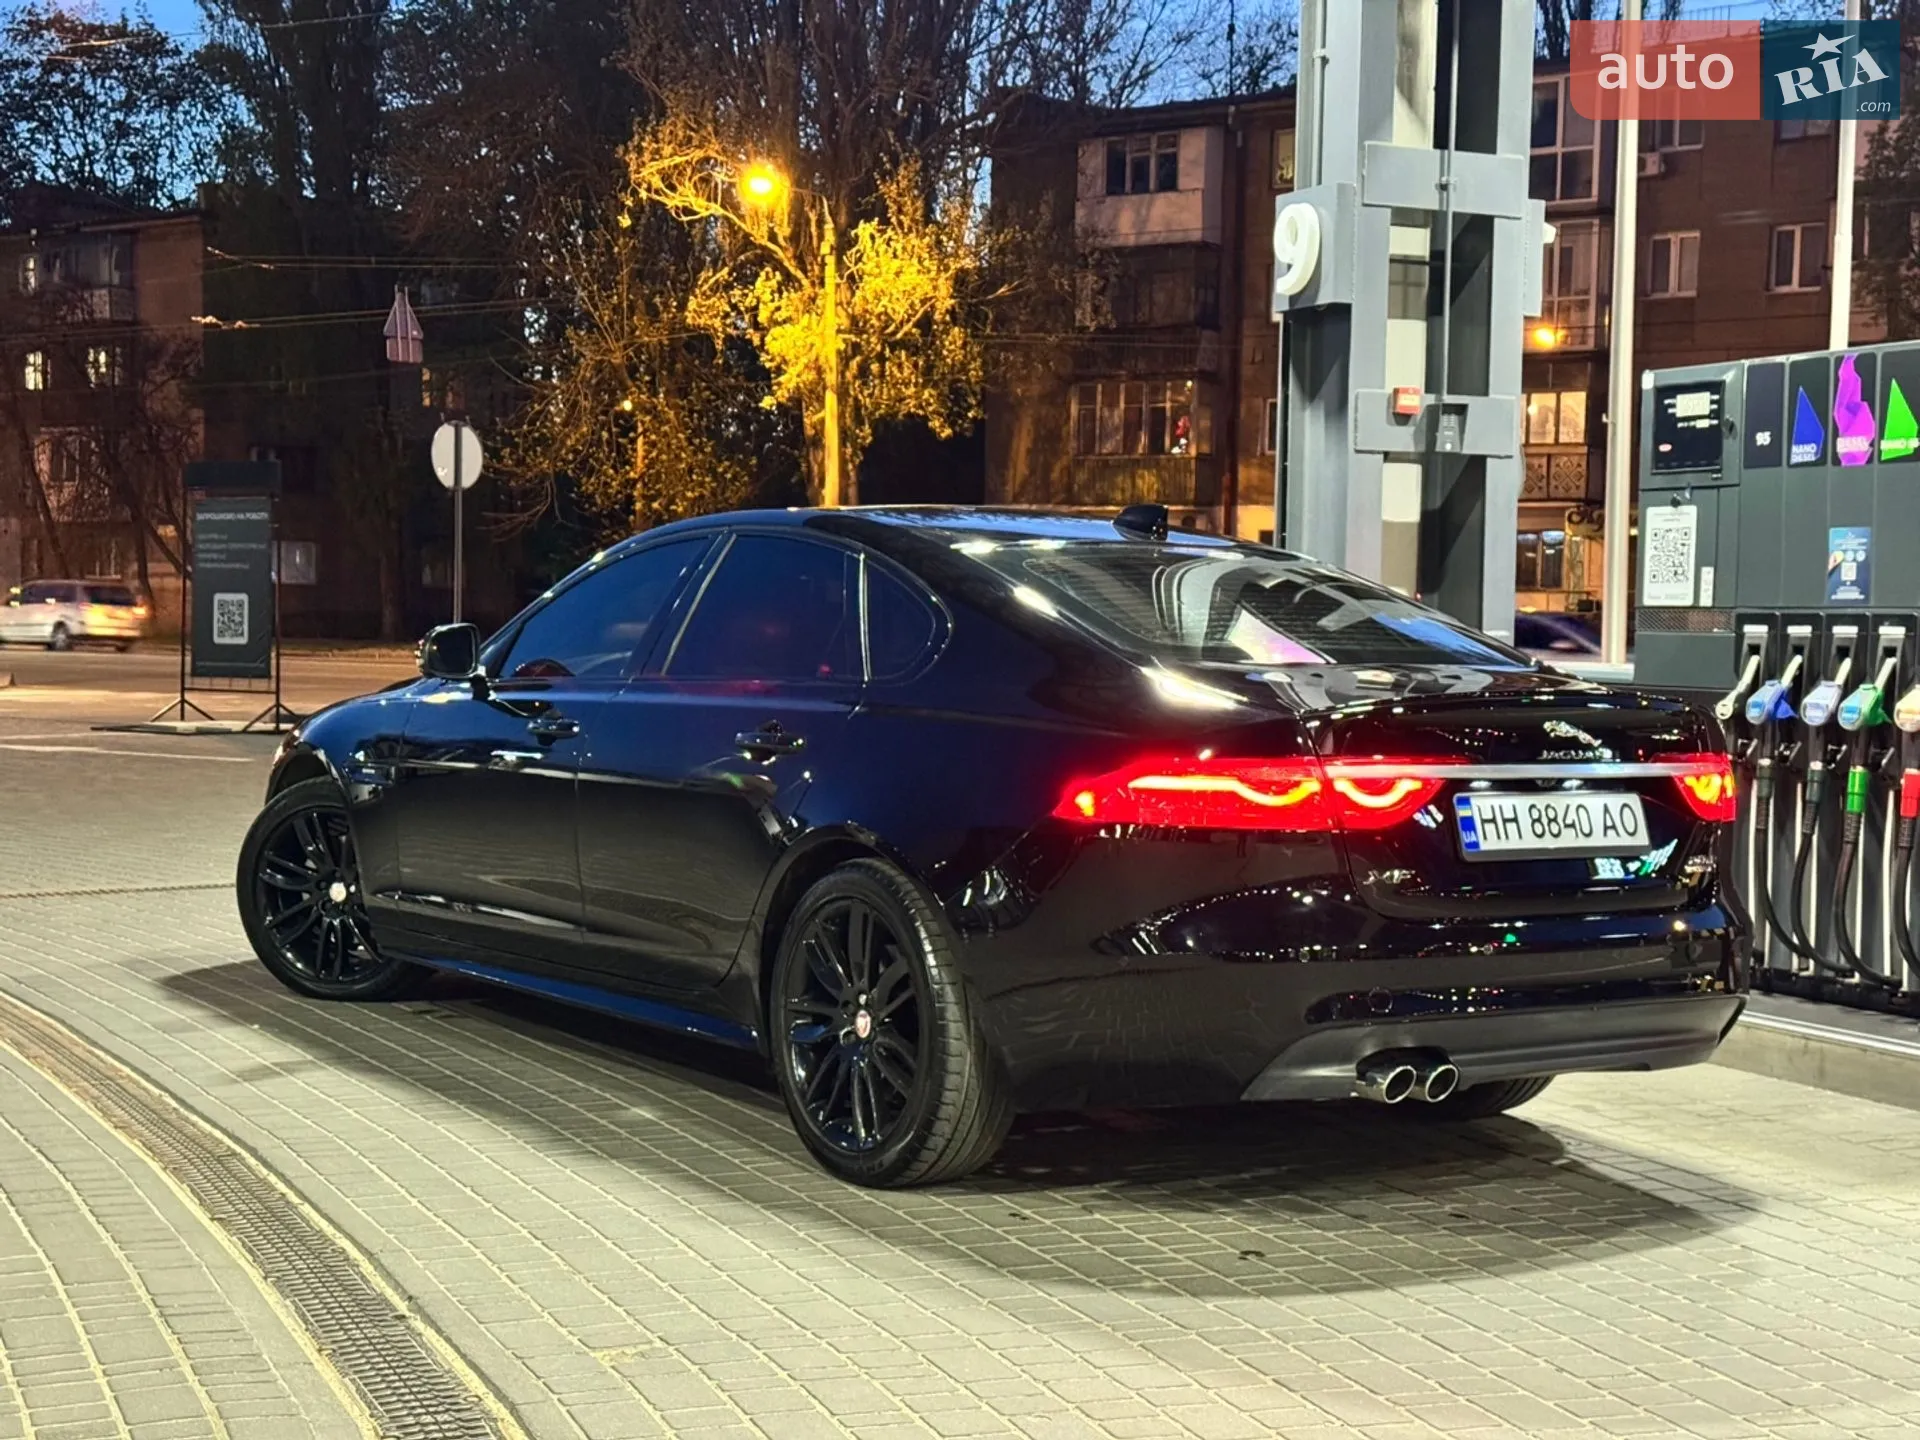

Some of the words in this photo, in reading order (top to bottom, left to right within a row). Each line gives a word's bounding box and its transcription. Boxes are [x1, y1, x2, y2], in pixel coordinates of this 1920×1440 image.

[1273, 203, 1320, 296] 9
[1791, 443, 1817, 453] NANO
[1477, 803, 1523, 841] HH
[1528, 803, 1594, 839] 8840
[1462, 831, 1477, 844] UA
